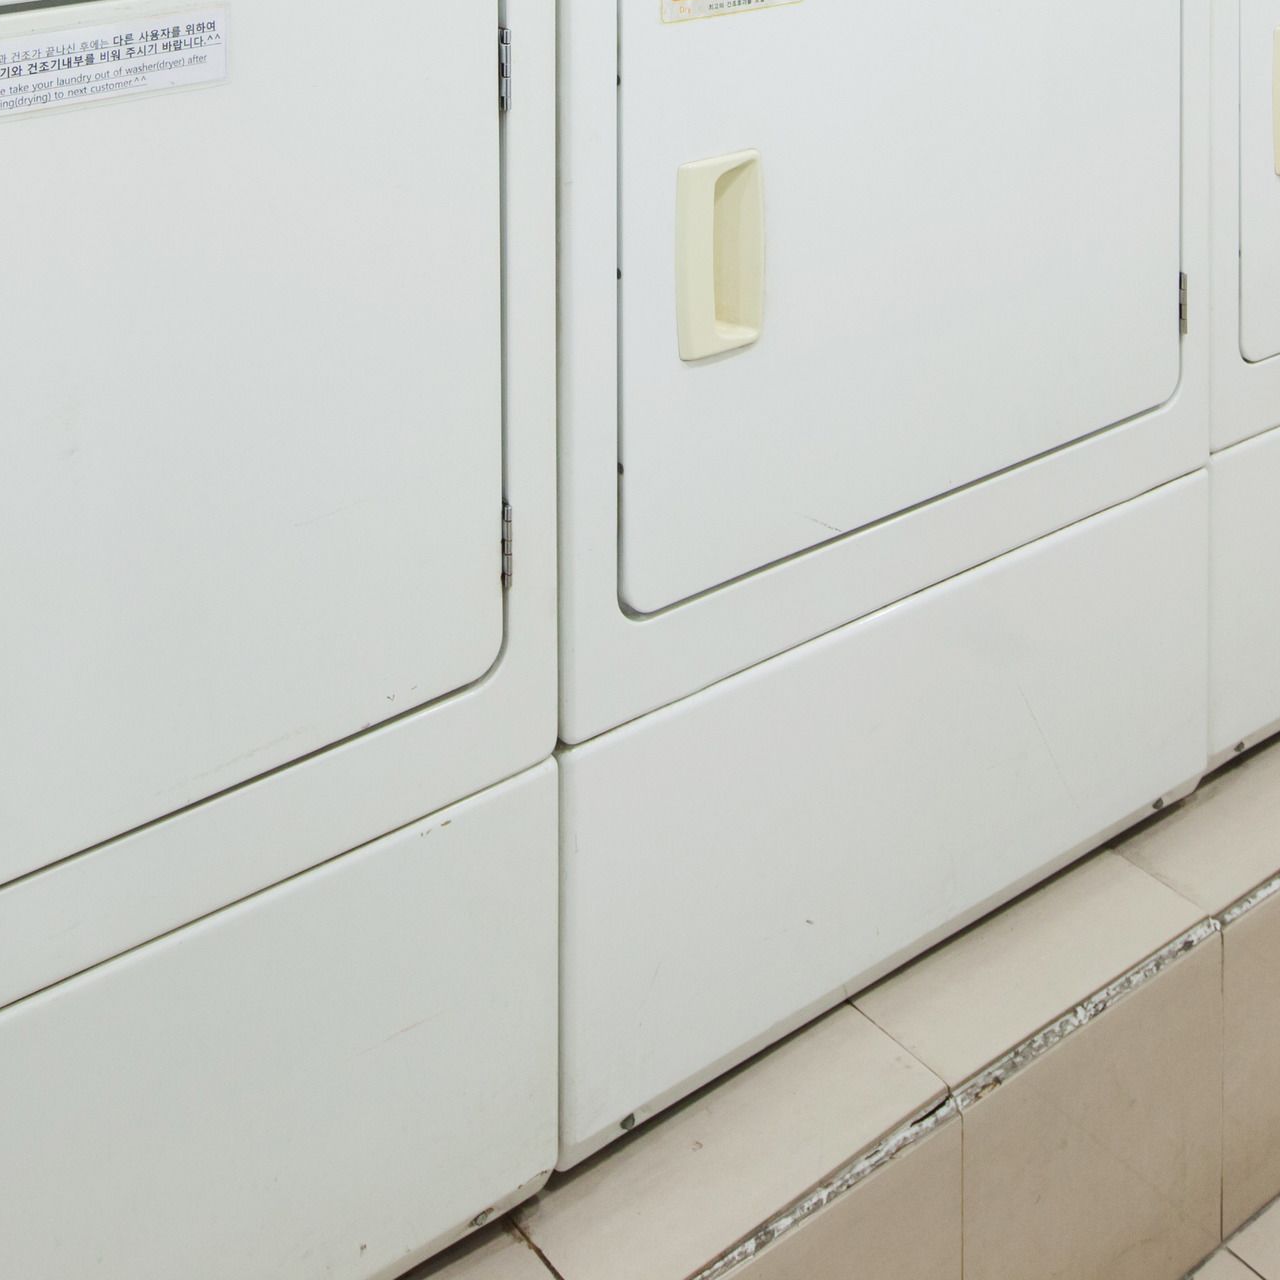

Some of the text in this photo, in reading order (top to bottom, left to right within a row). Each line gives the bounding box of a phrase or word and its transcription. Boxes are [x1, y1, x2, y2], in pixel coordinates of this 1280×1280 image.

[113, 32, 136, 47] 다른
[139, 25, 181, 44] 사용자를
[185, 19, 218, 36] 위하여
[8, 82, 29, 96] take
[32, 81, 54, 94] your
[56, 73, 92, 90] laundry
[95, 71, 111, 82] out
[113, 68, 124, 80] of
[125, 57, 185, 79] washer(dryer)
[187, 52, 209, 67] after
[27, 53, 95, 76] 건조기내부를
[99, 46, 122, 63] 비워
[125, 42, 158, 59] 주시기
[54, 88, 65, 100] to
[67, 86, 89, 98] next
